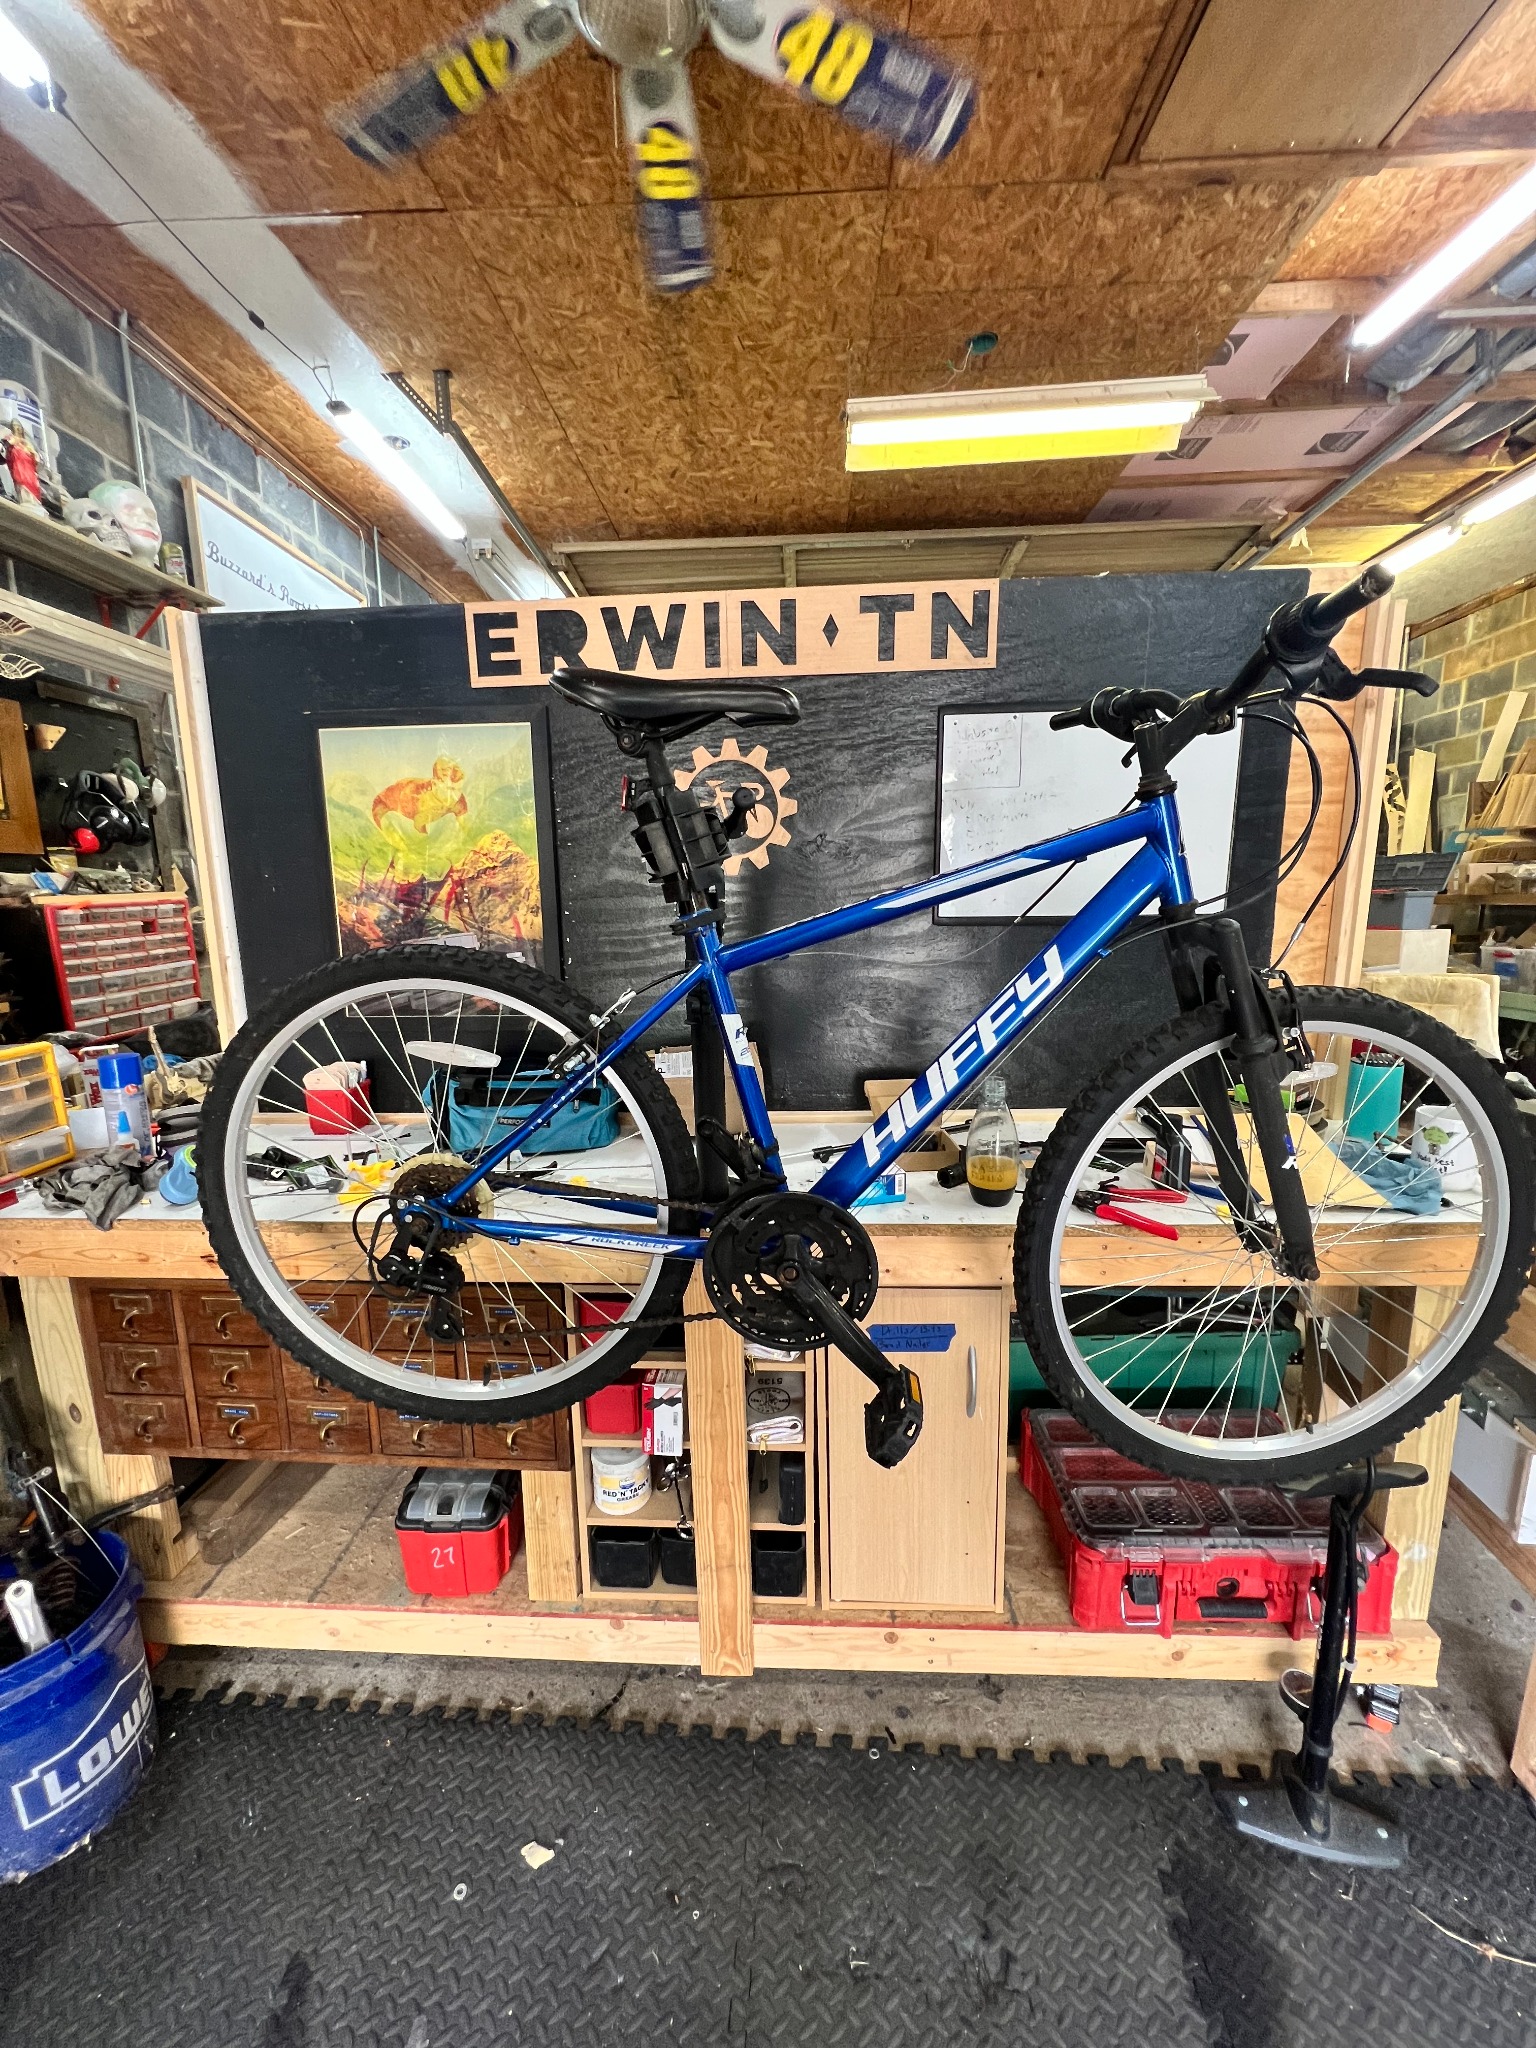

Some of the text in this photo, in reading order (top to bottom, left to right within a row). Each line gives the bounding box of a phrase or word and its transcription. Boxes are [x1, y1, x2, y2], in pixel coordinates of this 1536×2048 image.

[205, 540, 277, 598] Buzzard's
[473, 590, 990, 677] ERWIN TN
[863, 944, 1064, 1168] HUFFY
[602, 1489, 617, 1498] RED
[630, 1478, 649, 1494] TACKY
[616, 1492, 640, 1502] GREASE
